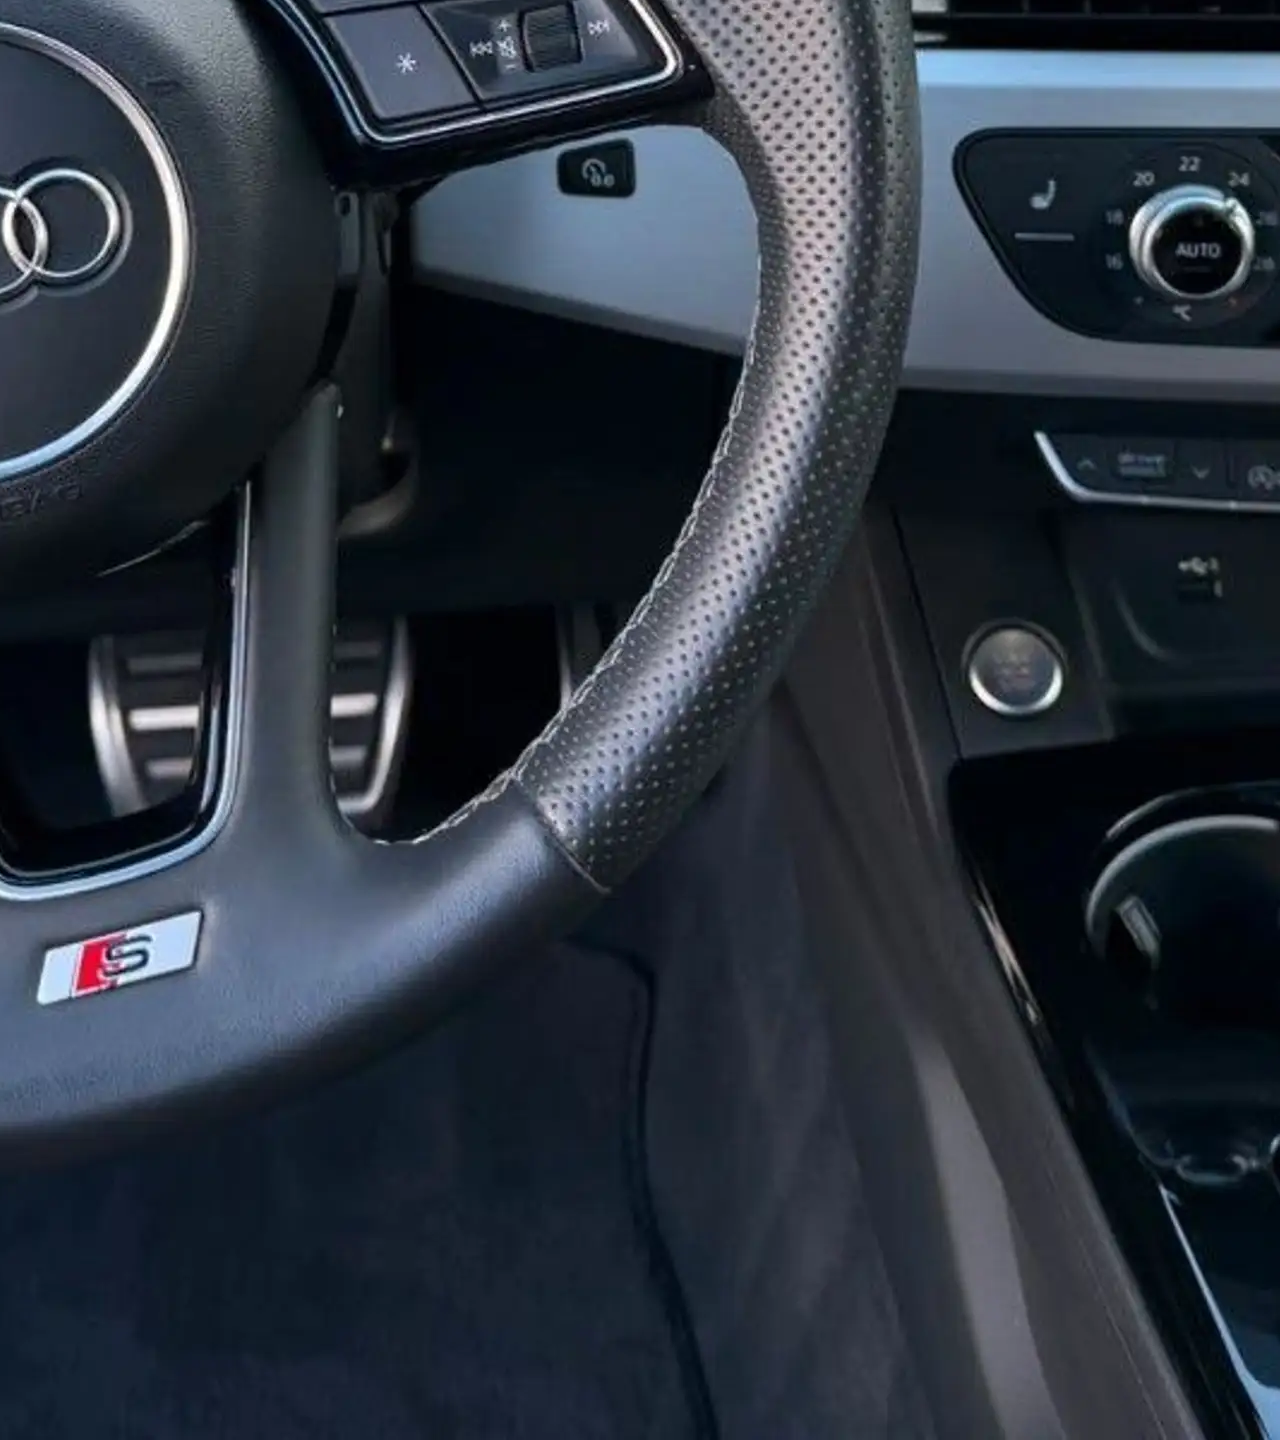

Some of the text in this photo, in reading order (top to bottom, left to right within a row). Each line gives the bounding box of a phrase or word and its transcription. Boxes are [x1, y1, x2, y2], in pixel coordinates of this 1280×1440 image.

[1178, 156, 1201, 172] 22
[1133, 171, 1156, 187] 20
[1228, 172, 1251, 187] 24
[1175, 242, 1221, 259] AUTO
